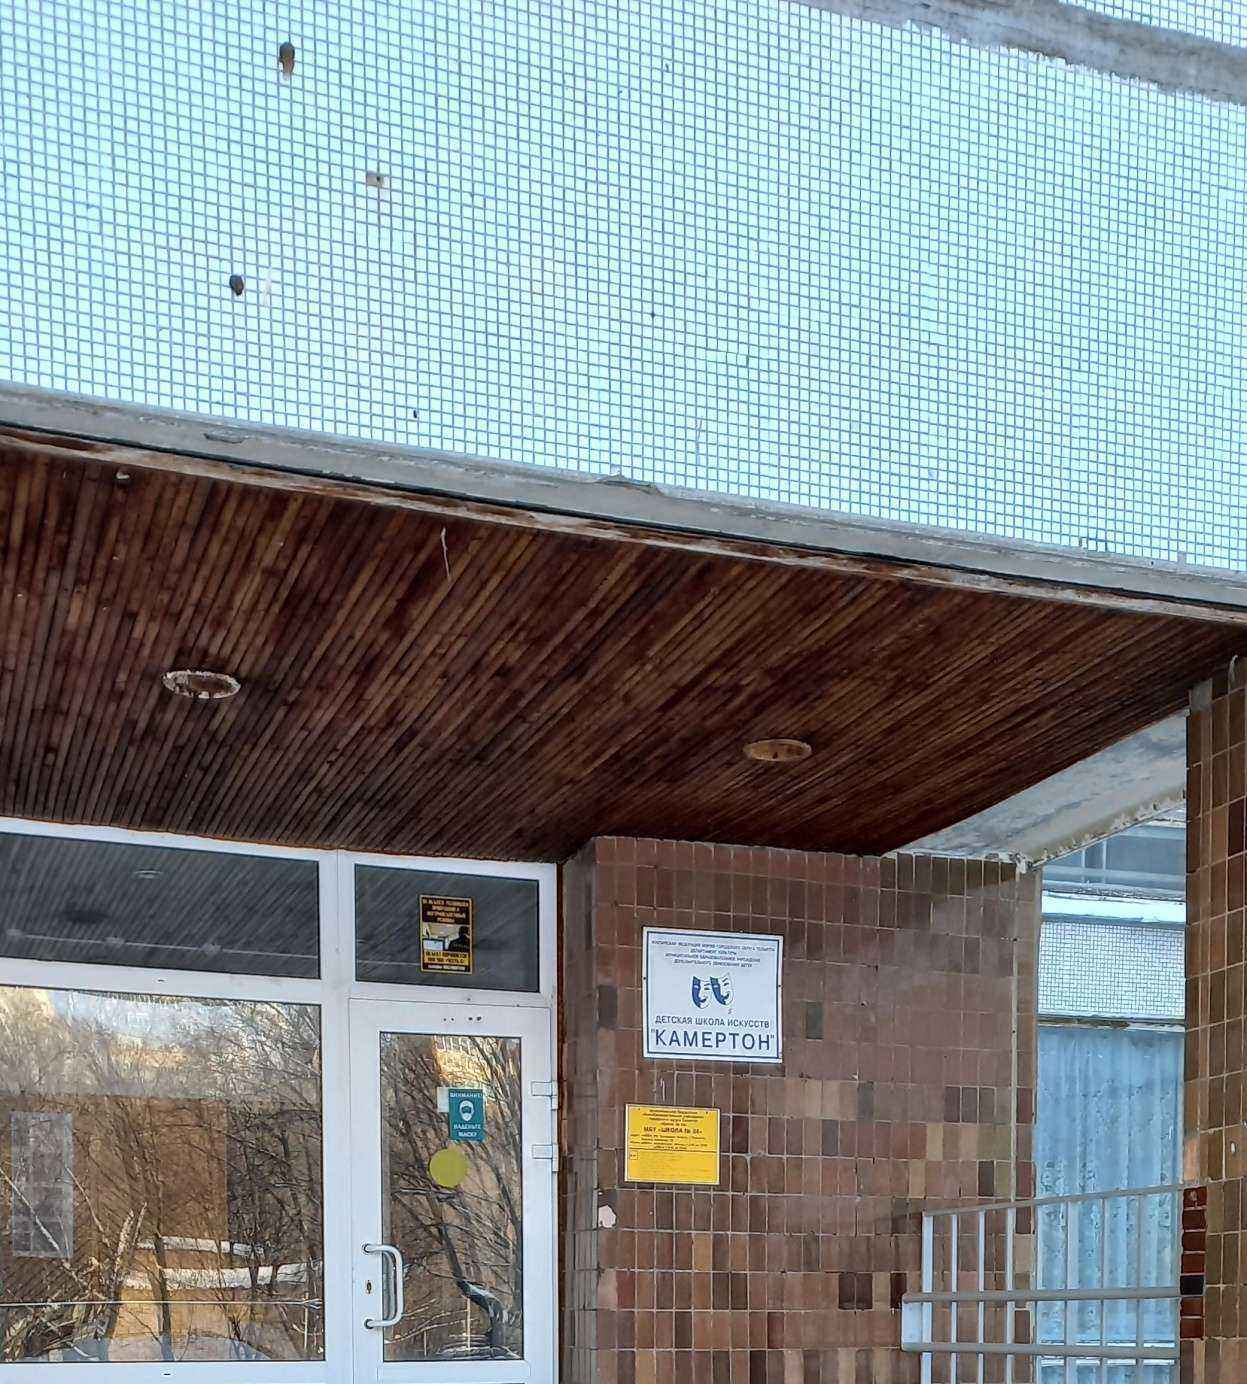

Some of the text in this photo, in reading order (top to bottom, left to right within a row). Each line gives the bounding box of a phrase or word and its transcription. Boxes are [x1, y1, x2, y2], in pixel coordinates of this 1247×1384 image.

[655, 1015, 770, 1029] ДЕТСКАЯ ШКОЛА ИСКУССТВ
